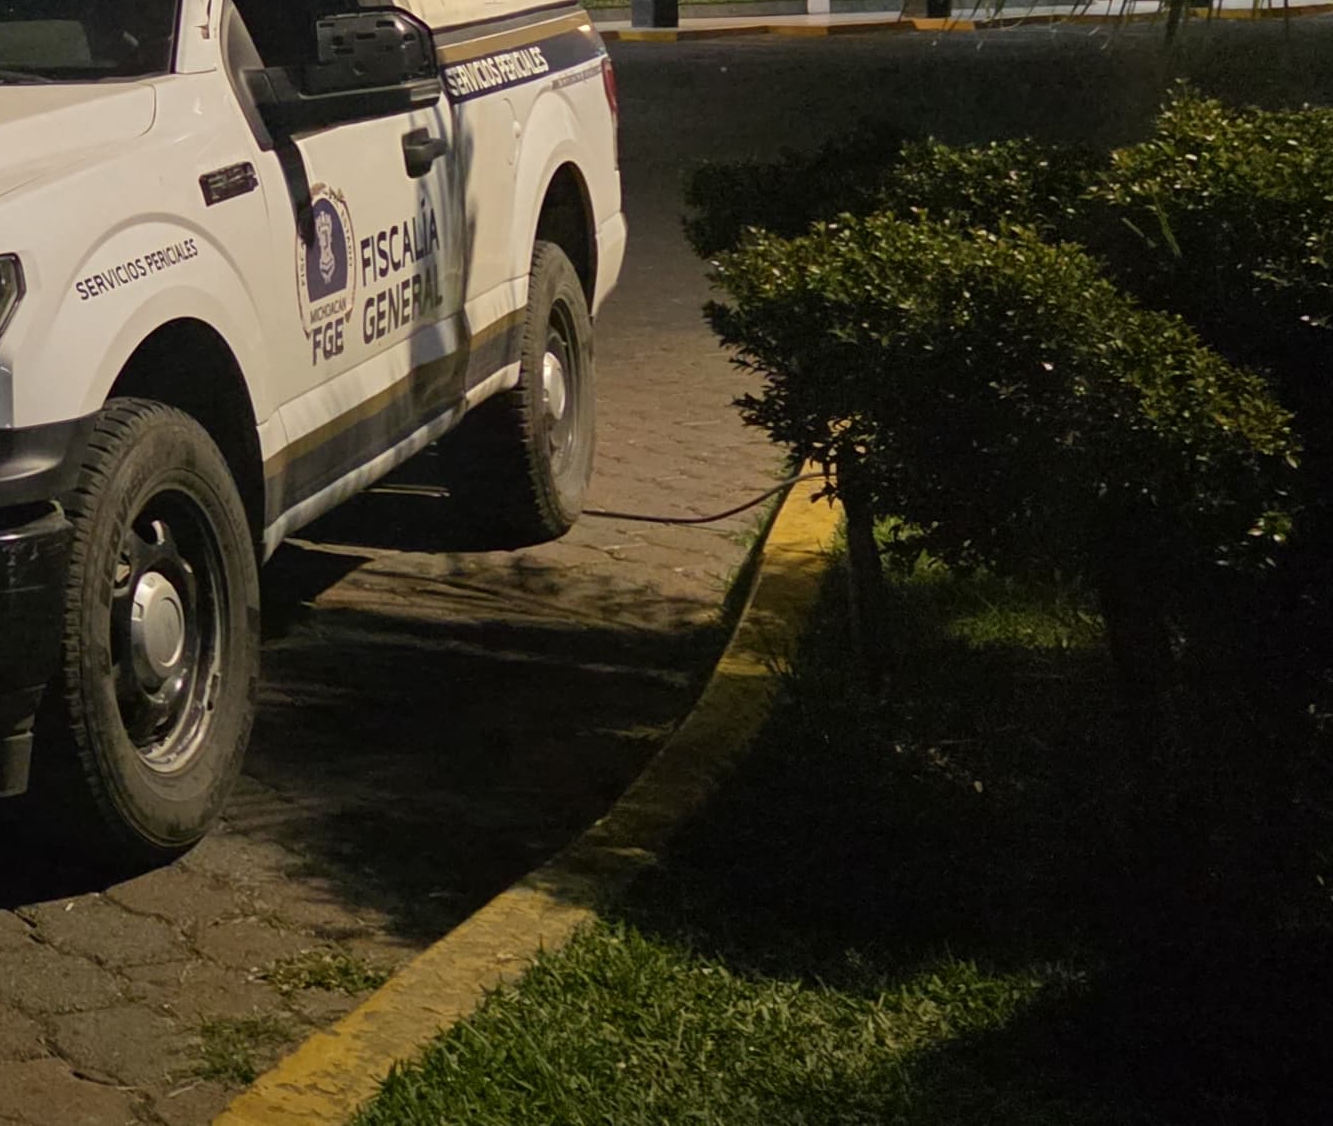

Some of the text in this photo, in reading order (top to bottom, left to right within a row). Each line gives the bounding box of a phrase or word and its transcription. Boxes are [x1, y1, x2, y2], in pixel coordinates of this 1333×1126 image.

[445, 57, 503, 96] SERVICIOS
[494, 46, 550, 83] PERICIALES
[75, 238, 199, 300] SERVICIOS PERICIALES
[362, 263, 443, 345] GENERAL
[312, 317, 345, 366] FGE
